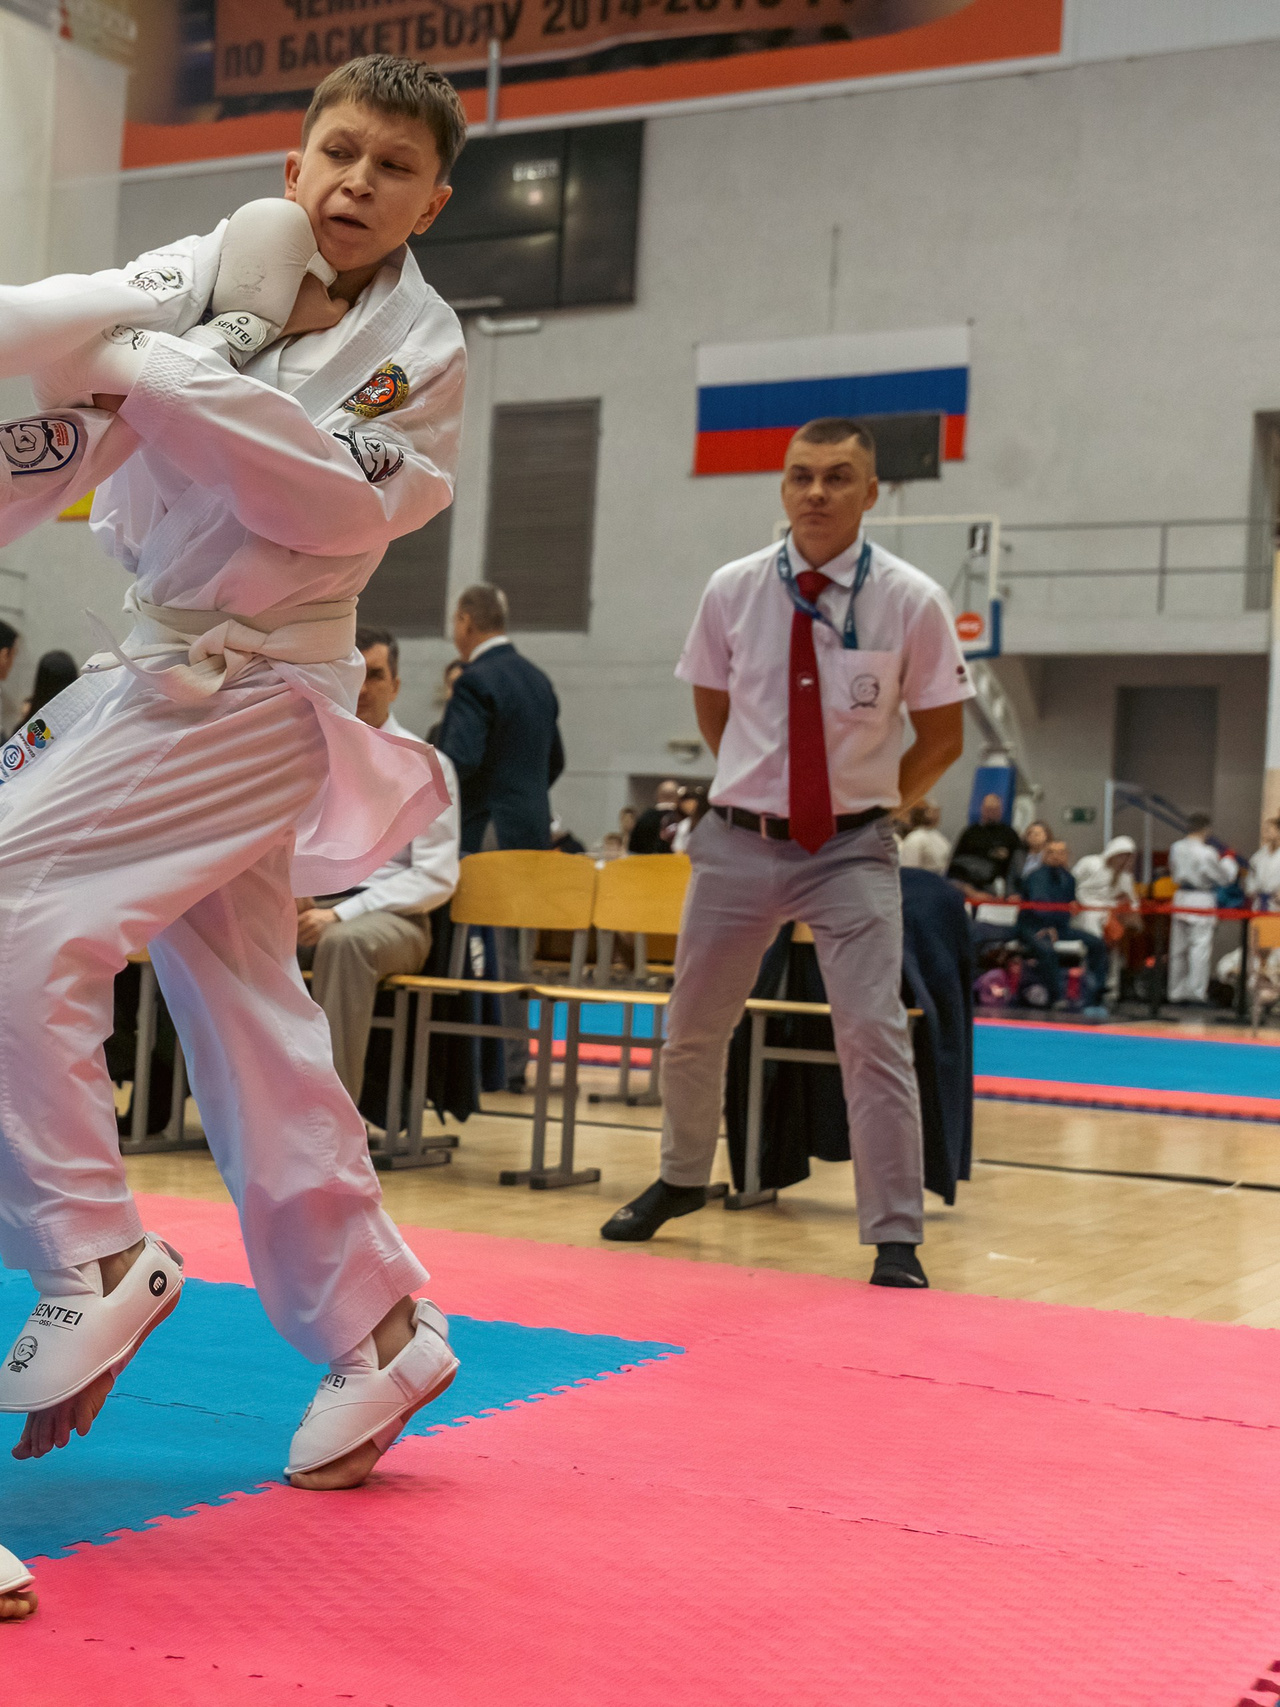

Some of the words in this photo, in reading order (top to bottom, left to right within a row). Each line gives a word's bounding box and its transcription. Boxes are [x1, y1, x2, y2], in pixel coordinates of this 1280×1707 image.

[224, 40, 265, 78] ПО
[278, 1, 521, 72] БАСКЕТБОЛУ
[214, 320, 253, 345] SENTEI
[32, 723, 46, 741] WKF
[32, 1303, 83, 1325] SENTEI
